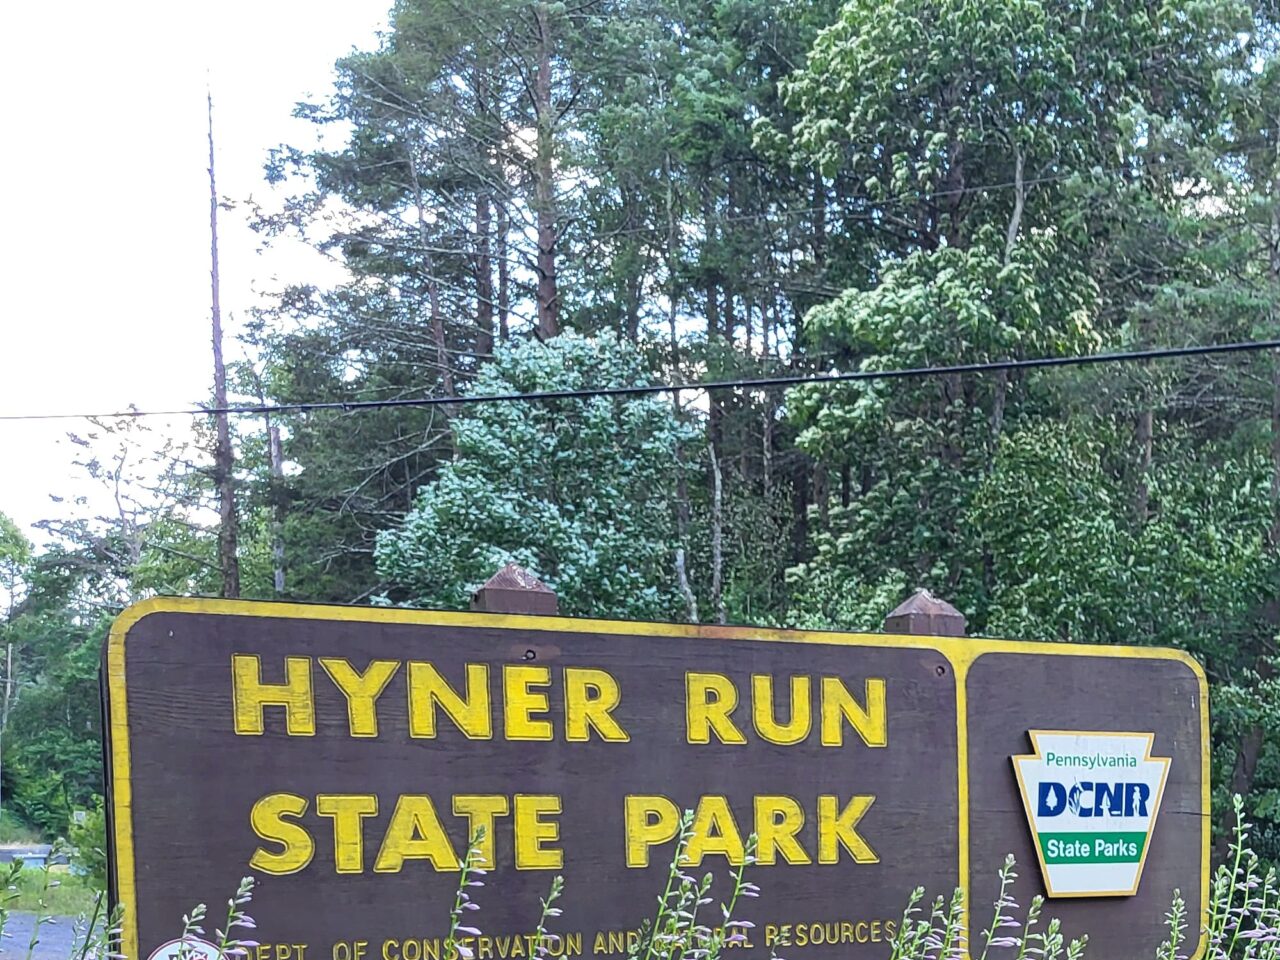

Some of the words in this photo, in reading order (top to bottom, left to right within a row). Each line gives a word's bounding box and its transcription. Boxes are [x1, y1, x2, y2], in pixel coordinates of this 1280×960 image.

[231, 652, 630, 743] HYNER
[685, 672, 888, 747] RUN
[1046, 752, 1137, 770] Pennsylvania
[1037, 781, 1150, 818] DCNR
[248, 793, 563, 875] STATE
[624, 794, 880, 868] PARK
[1047, 839, 1090, 858] State
[1094, 839, 1137, 857] Parks
[593, 931, 642, 954] AND
[764, 919, 897, 947] RESOURCES
